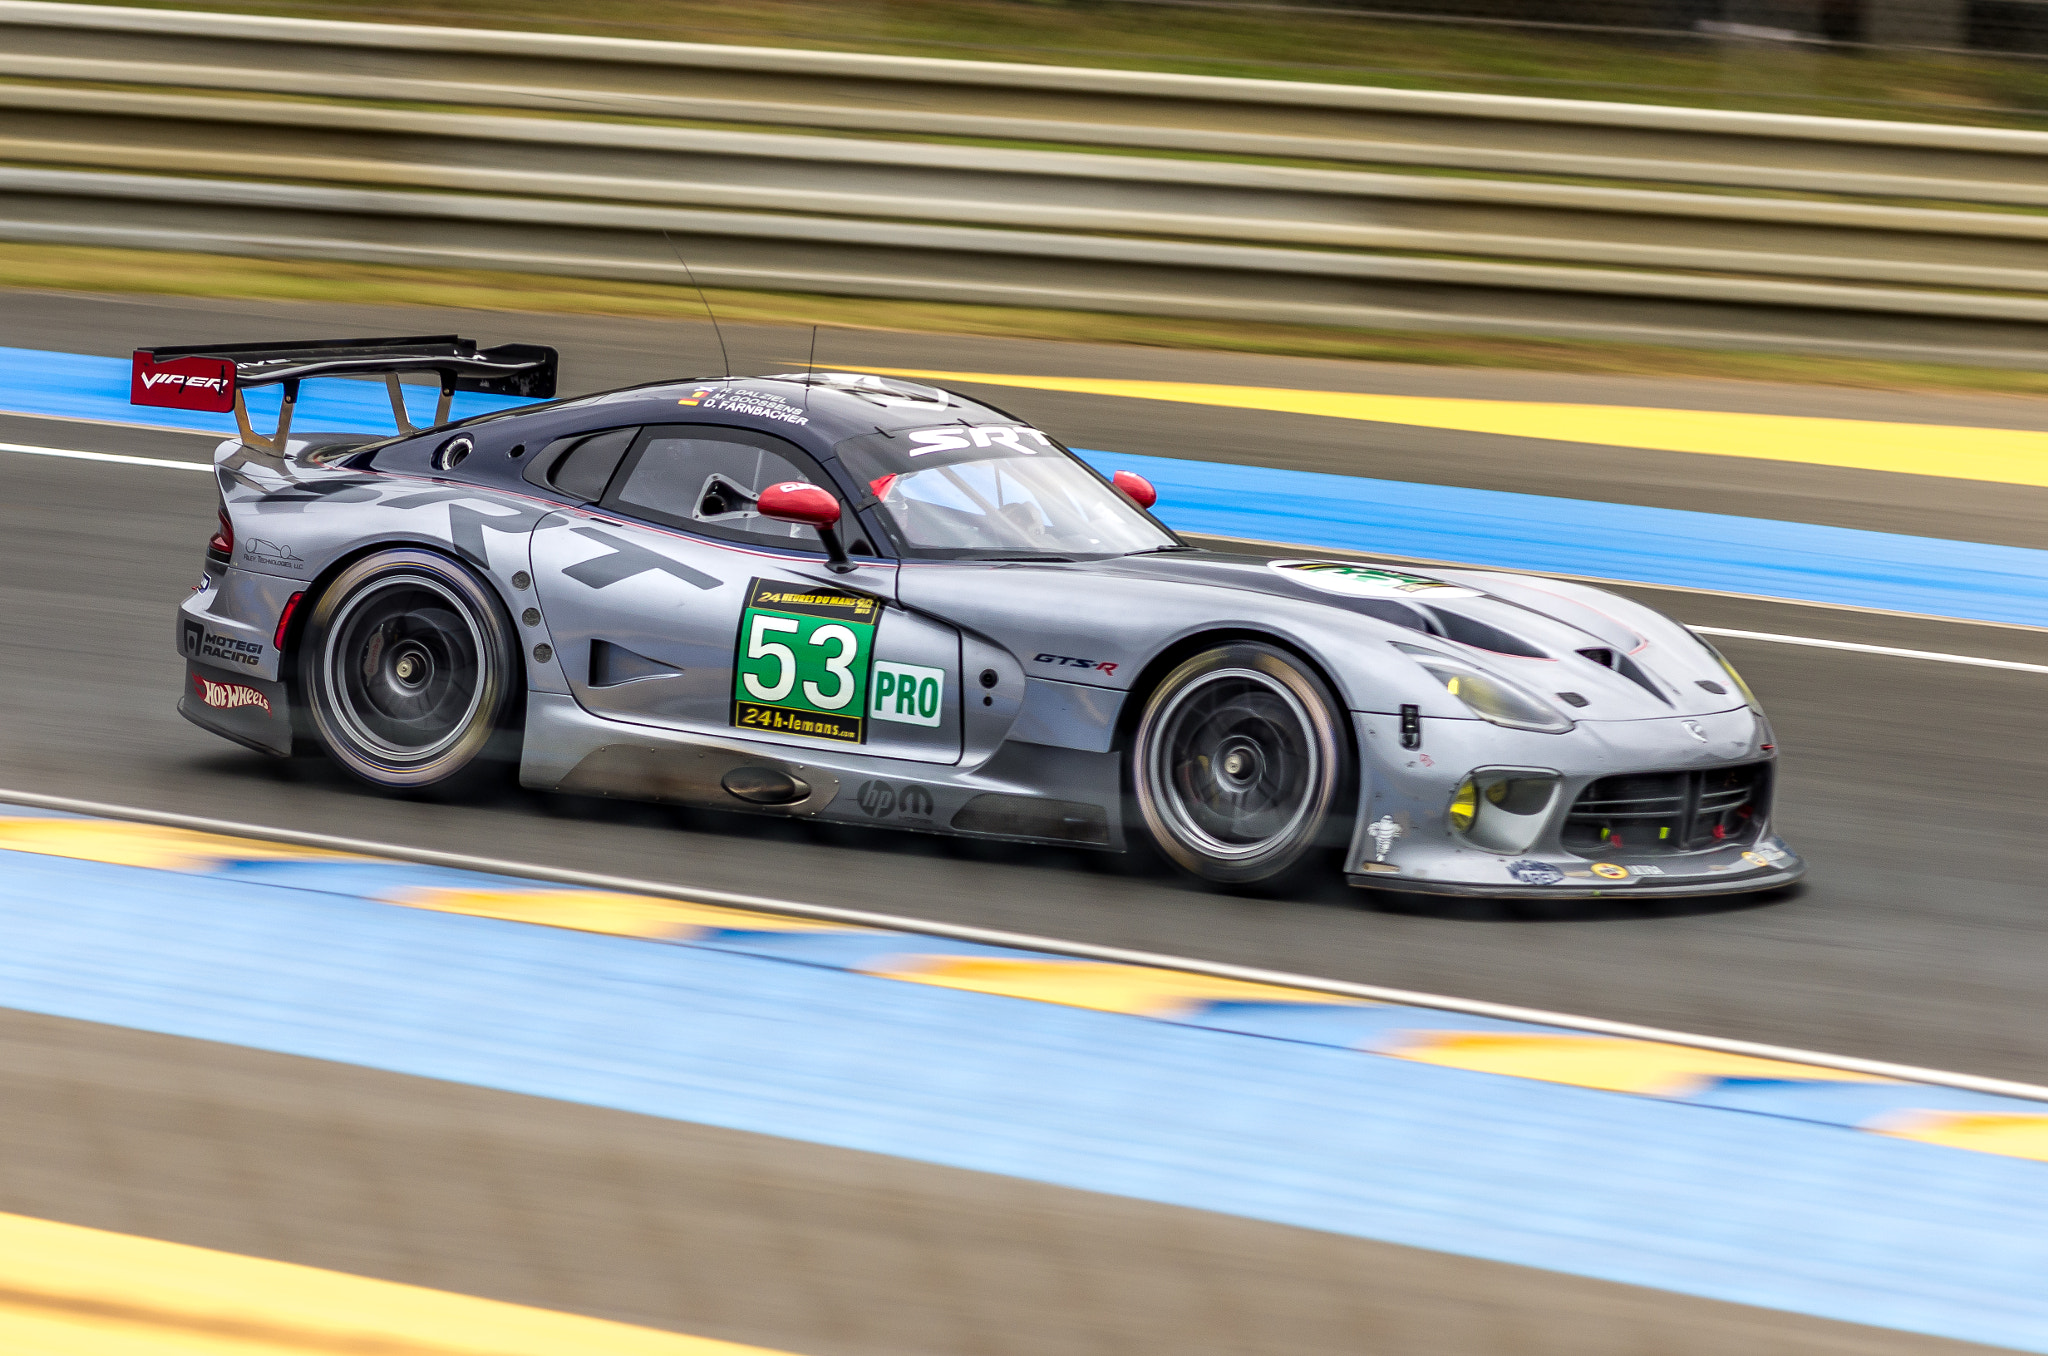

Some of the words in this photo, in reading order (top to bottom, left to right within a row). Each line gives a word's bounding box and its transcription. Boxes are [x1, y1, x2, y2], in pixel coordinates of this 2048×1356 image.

[141, 371, 228, 394] VIPER
[712, 393, 726, 401] M.
[729, 395, 803, 416] GOOSSENS
[735, 389, 788, 404] DALZIEL
[703, 399, 716, 409] D.
[718, 401, 809, 426] FARNBACHER
[908, 426, 1051, 458] SRT
[757, 591, 781, 603] 24
[781, 593, 815, 603] HEURES
[815, 595, 830, 604] DU
[830, 596, 856, 606] MANS
[202, 644, 260, 666] RACING
[204, 633, 263, 655] MOTEGI
[742, 613, 859, 711] 53
[1033, 653, 1119, 677] GTS-R
[874, 671, 939, 719] PRO
[861, 780, 893, 817] hp
